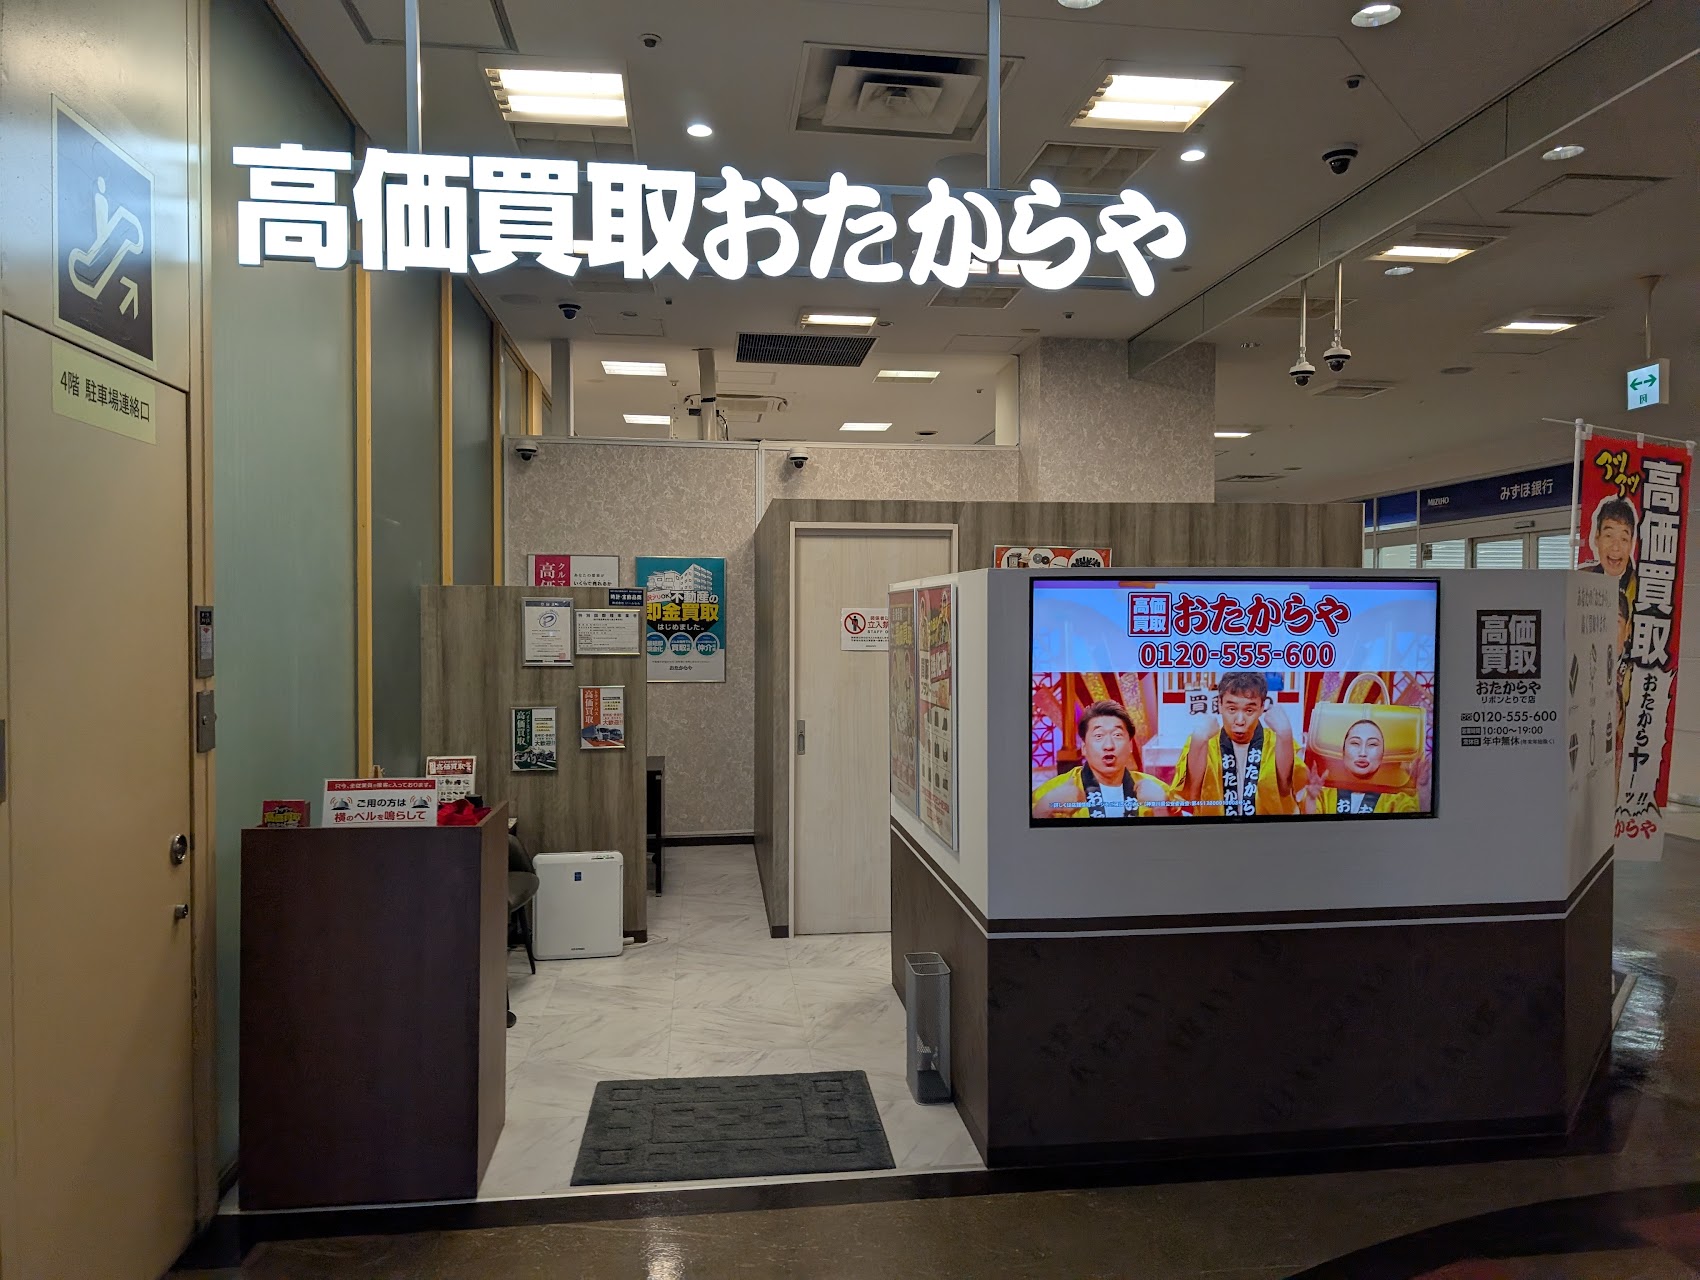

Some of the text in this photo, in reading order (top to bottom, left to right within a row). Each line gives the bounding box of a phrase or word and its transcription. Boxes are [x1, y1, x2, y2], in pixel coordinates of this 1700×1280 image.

[232, 142, 1187, 297] 高価買取おたからや
[60, 371, 150, 422] 4階 駐車場連絡口
[1500, 478, 1553, 501] みずほ銀行
[1427, 496, 1449, 505] MIZUHO
[1631, 460, 1682, 665] 高価買取
[671, 591, 719, 604] 不動産の
[647, 603, 719, 622] 即金買取
[1172, 592, 1352, 636] おたからや
[657, 623, 705, 631] はじめました。
[1139, 641, 1336, 669] 0120-555-600
[1476, 681, 1541, 695] おたからや
[1481, 696, 1536, 704] リボンとりで店
[1473, 710, 1557, 723] 0120-555-600
[1483, 736, 1520, 746] 年中無休
[357, 799, 406, 807] ご用の方は
[335, 811, 427, 822] 横のベルを鳴らして
